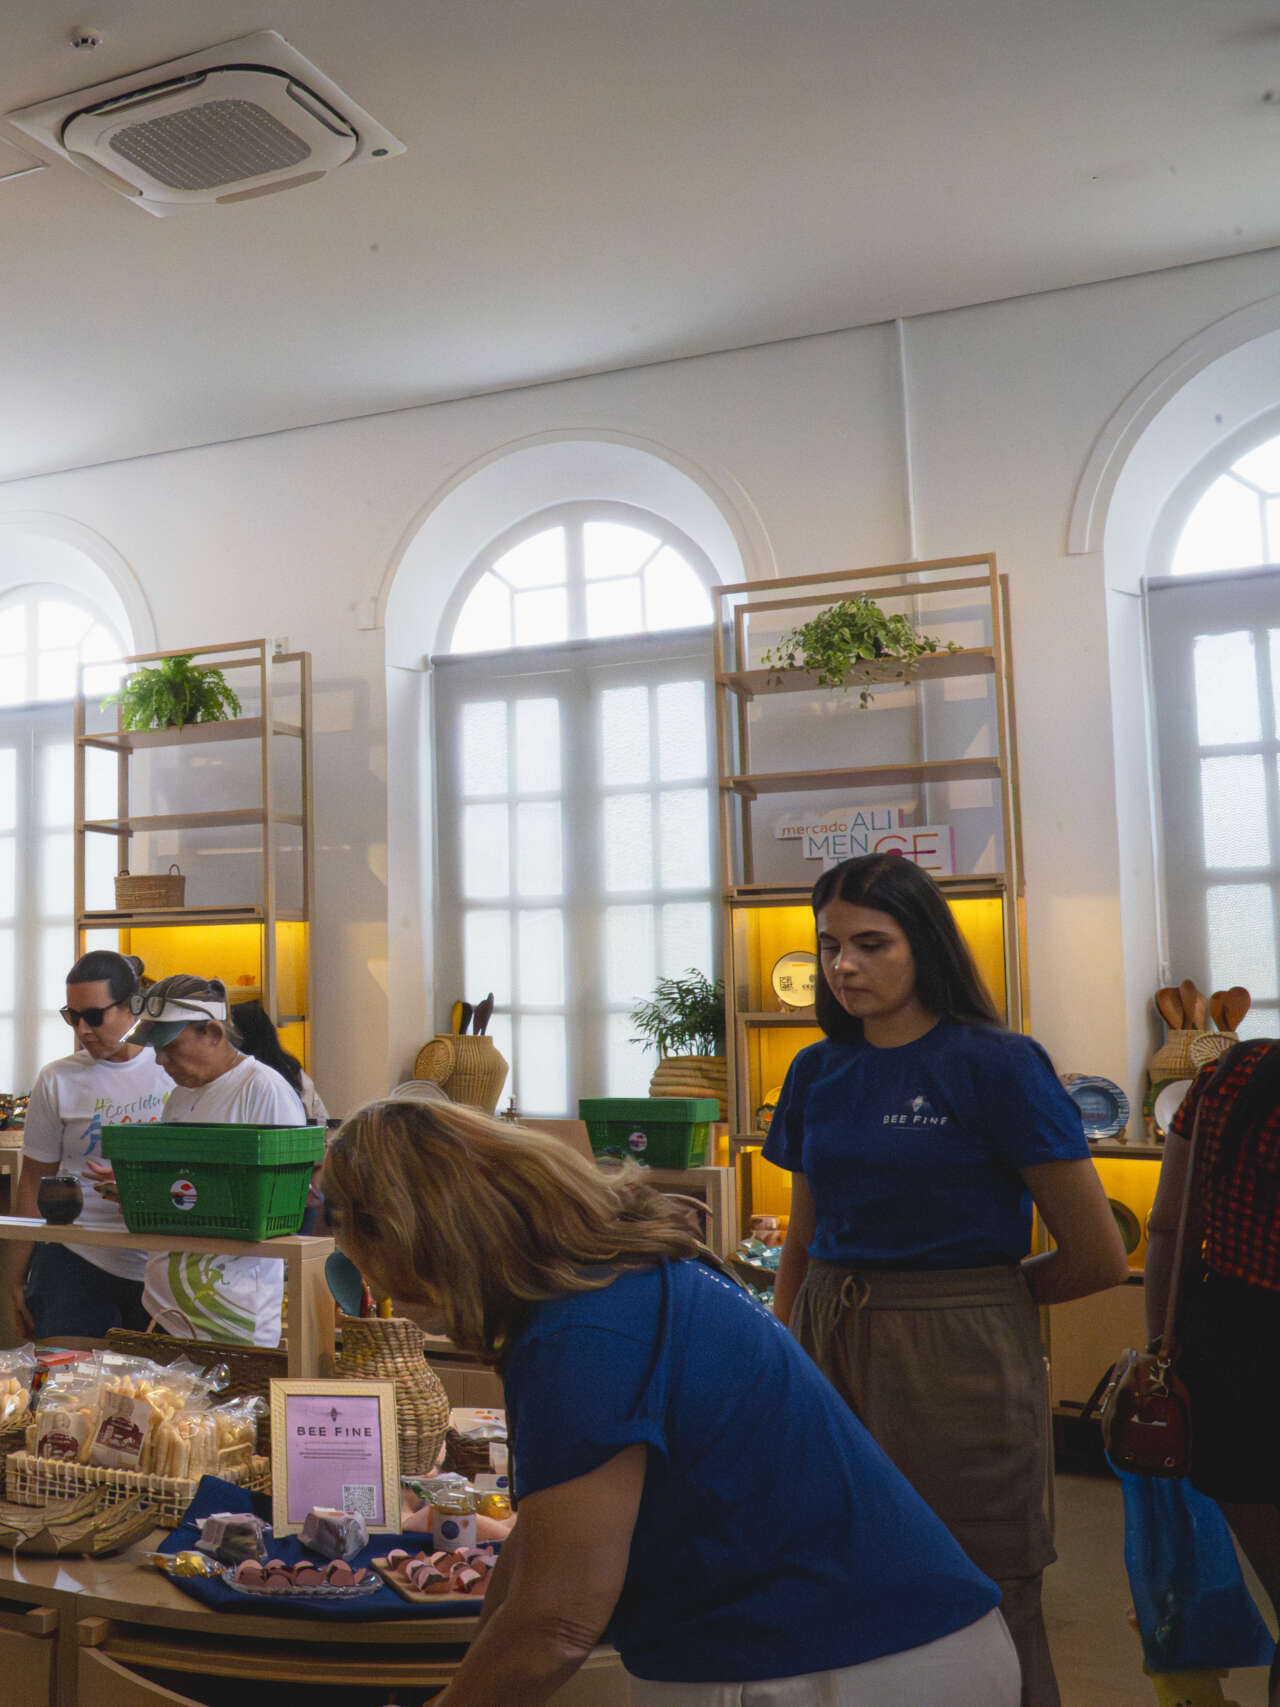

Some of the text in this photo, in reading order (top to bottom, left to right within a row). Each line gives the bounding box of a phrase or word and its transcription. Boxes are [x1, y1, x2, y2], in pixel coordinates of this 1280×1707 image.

[782, 810, 892, 836] mercado ALI
[808, 833, 868, 857] MEN
[882, 1114, 948, 1125] BEE FINE
[296, 1426, 372, 1437] BEE FINE
